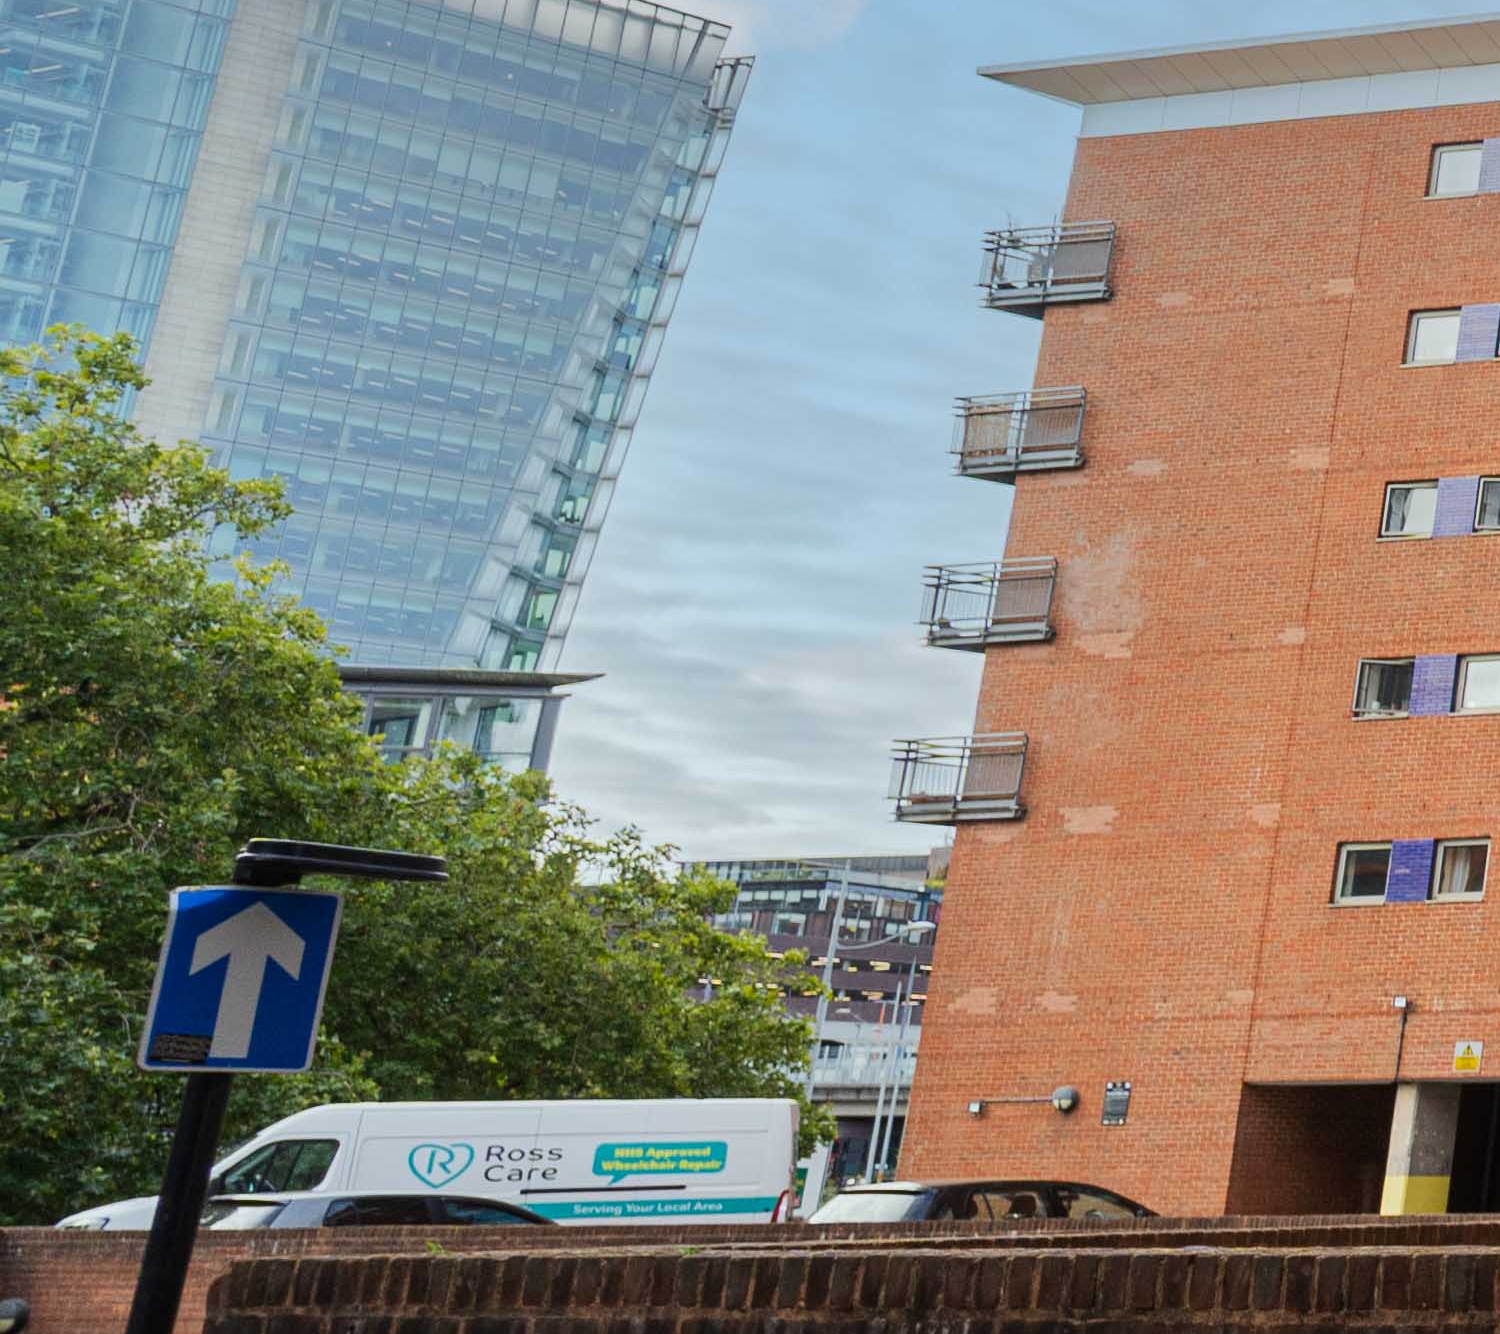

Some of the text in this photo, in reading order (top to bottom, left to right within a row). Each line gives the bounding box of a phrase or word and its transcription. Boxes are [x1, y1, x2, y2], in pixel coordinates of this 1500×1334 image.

[484, 1145, 563, 1162] Ross
[646, 1147, 711, 1160] Approved
[601, 1158, 722, 1171] Wheelchair Repair
[484, 1165, 558, 1182] Care
[573, 1202, 723, 1215] Serving Your Local Area
